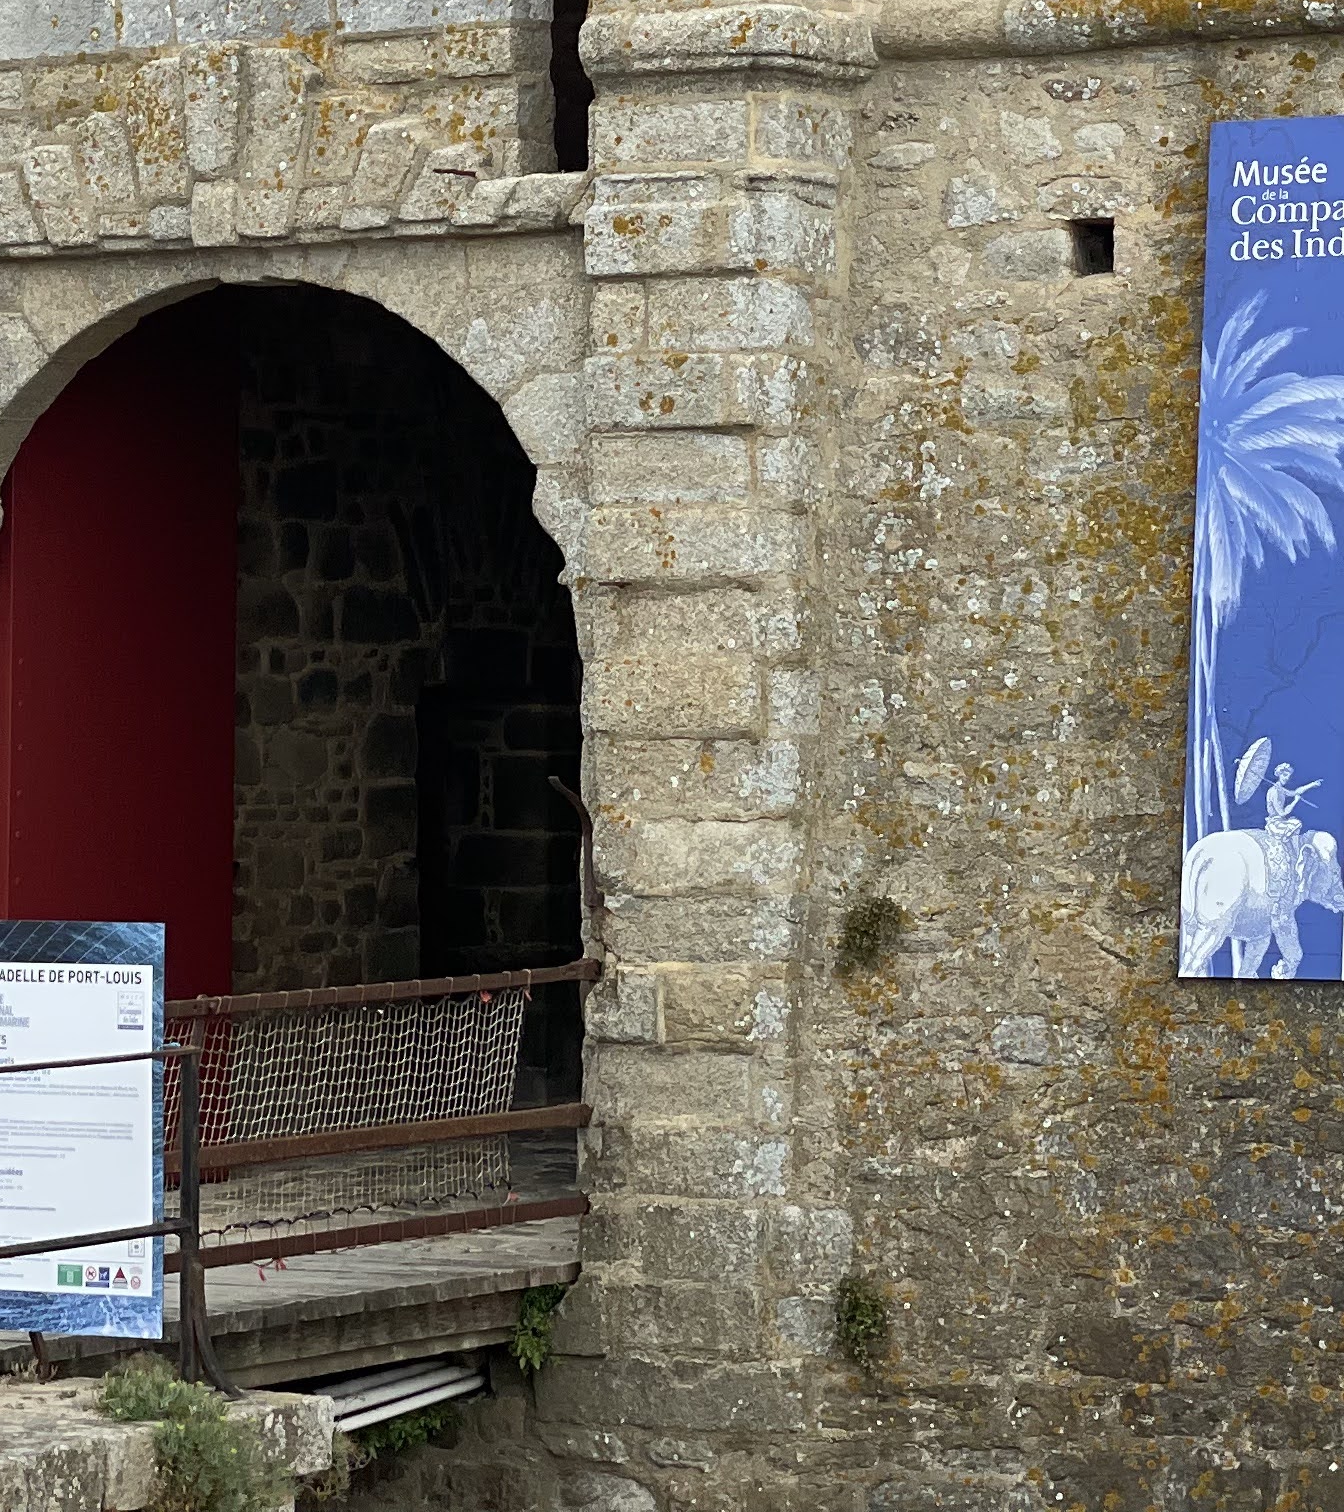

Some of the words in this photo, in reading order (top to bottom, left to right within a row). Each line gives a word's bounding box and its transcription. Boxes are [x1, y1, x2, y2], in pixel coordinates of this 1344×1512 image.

[1233, 156, 1328, 187] Musée
[1262, 189, 1276, 201] de
[1279, 188, 1289, 200] la
[1230, 231, 1284, 261] des
[49, 970, 65, 983] DE
[68, 971, 142, 985] PORT-LOUIS
[0, 1017, 31, 1028] MARINE
